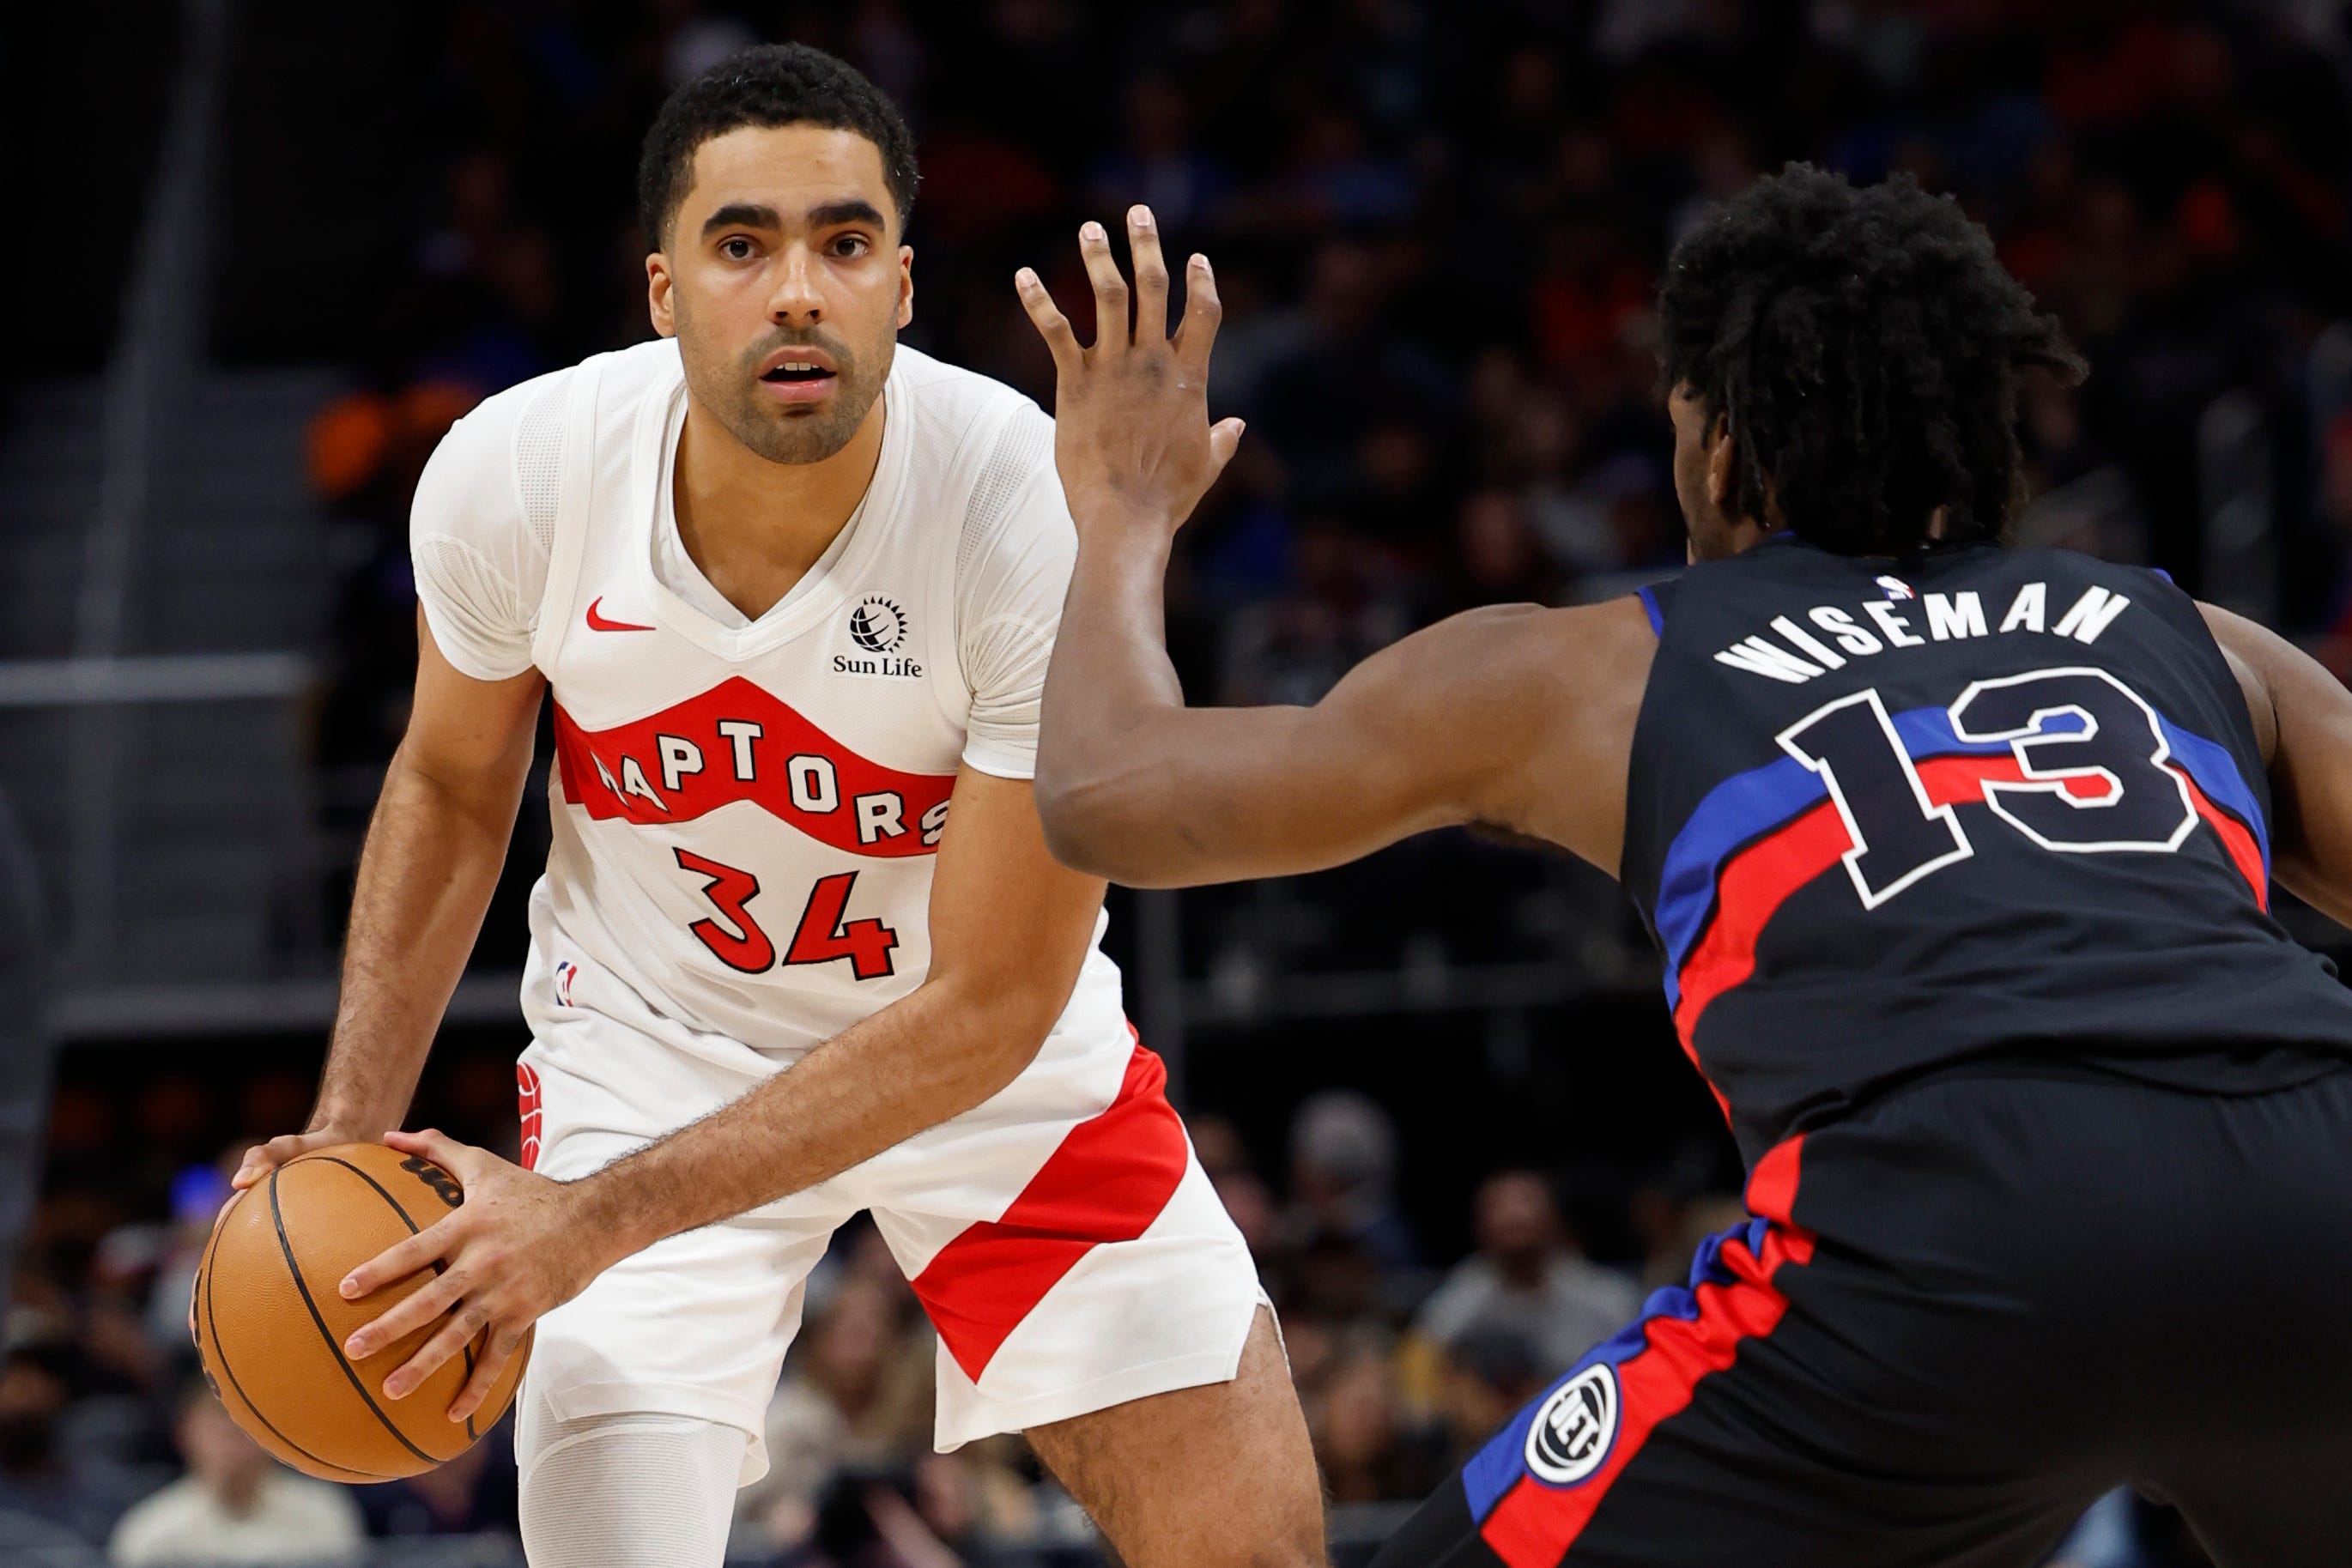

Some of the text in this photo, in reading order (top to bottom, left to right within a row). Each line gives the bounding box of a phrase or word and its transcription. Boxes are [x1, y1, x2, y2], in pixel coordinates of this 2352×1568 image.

[834, 655, 923, 677] Sun Life
[1713, 582, 2131, 684] WISEMAN
[1774, 666, 2199, 911] 13
[672, 846, 900, 982] 34
